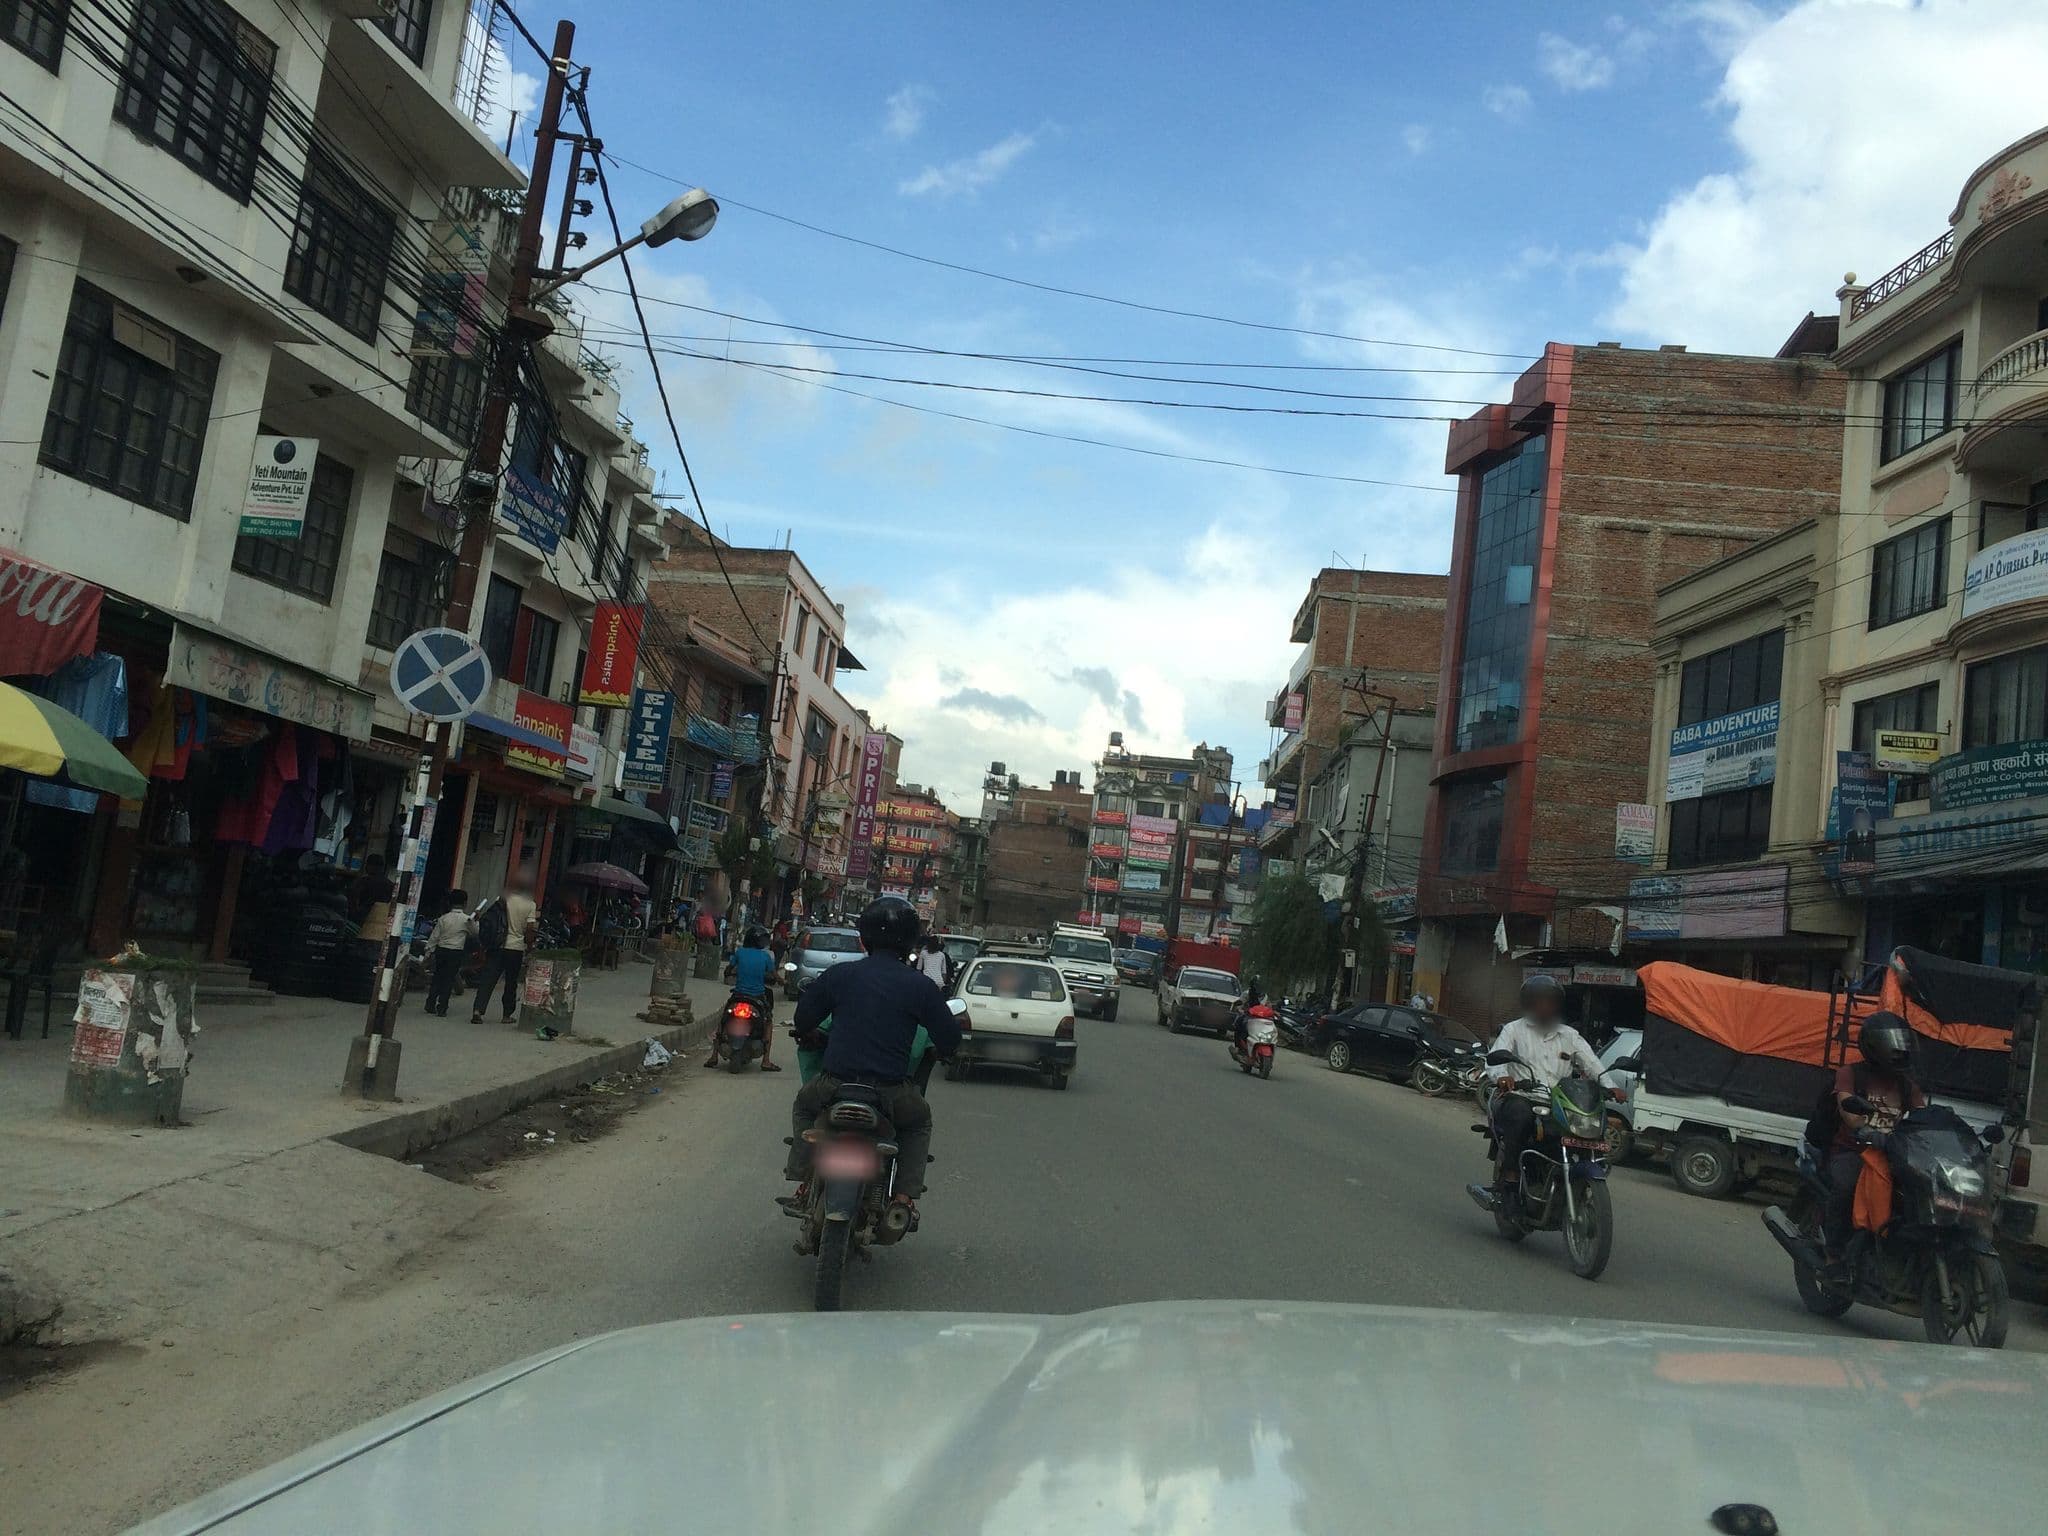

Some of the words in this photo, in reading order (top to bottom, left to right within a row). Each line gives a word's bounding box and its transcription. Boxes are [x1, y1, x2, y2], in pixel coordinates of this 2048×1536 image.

[254, 465, 270, 478] Yeti
[270, 466, 308, 481] Mountain
[250, 482, 280, 493] Adventure
[281, 484, 292, 494] Pvt.
[293, 485, 305, 495] Ltd.
[601, 613, 621, 685] asianpaints
[635, 693, 665, 761] ELITE
[1673, 726, 1702, 745] BABA
[1704, 704, 1779, 737] ADVENTURE
[1738, 728, 1755, 739] TOUR
[1882, 735, 1914, 743] WESTERN
[1716, 745, 1734, 760] BABA
[1735, 733, 1777, 756] ADVENTURE
[1991, 751, 2031, 771] सहकारी
[1973, 775, 1998, 785] Credit
[1841, 782, 1865, 794] Shirting
[1867, 798, 1887, 808] Center
[1899, 807, 2035, 857] SAMSUNG
[818, 864, 841, 873] BANK
